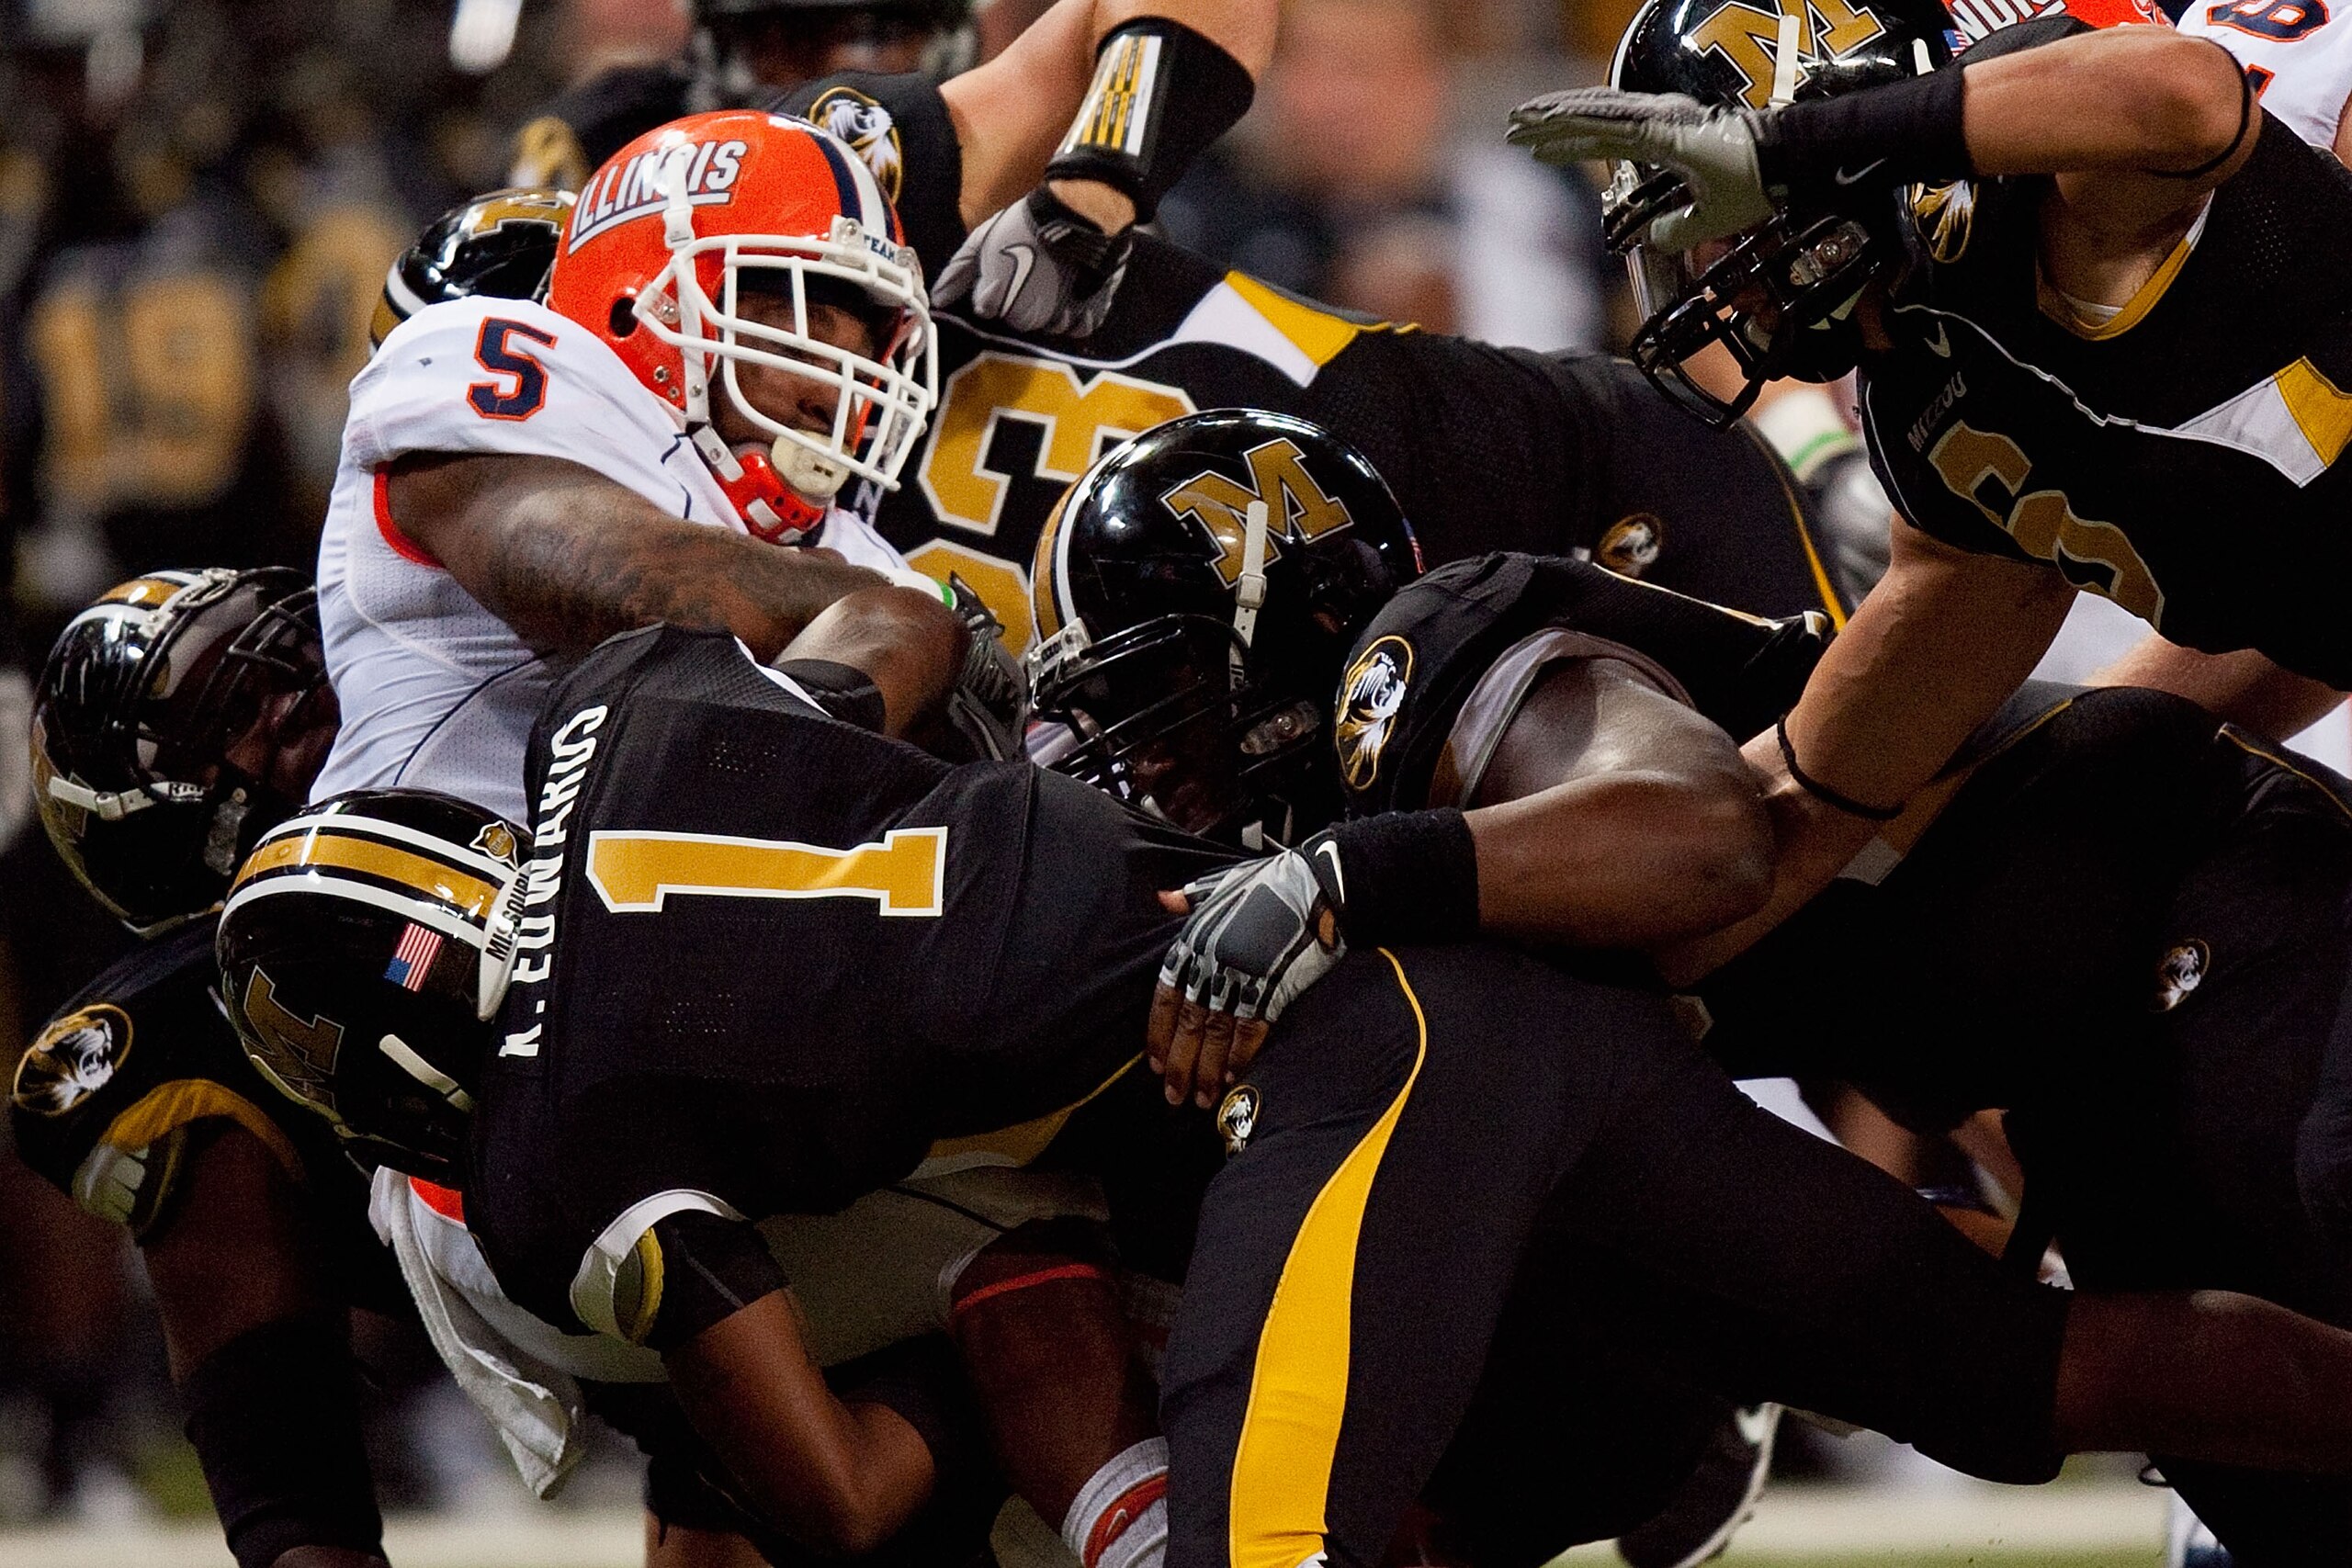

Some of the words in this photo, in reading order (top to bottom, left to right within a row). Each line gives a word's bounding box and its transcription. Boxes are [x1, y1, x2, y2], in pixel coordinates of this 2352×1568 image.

[1680, 0, 1886, 111] M
[466, 316, 559, 423] 5
[1906, 370, 1968, 453] MIZZOU
[1157, 436, 1355, 591] M
[484, 873, 531, 963] MISOURI
[585, 826, 948, 918] 1
